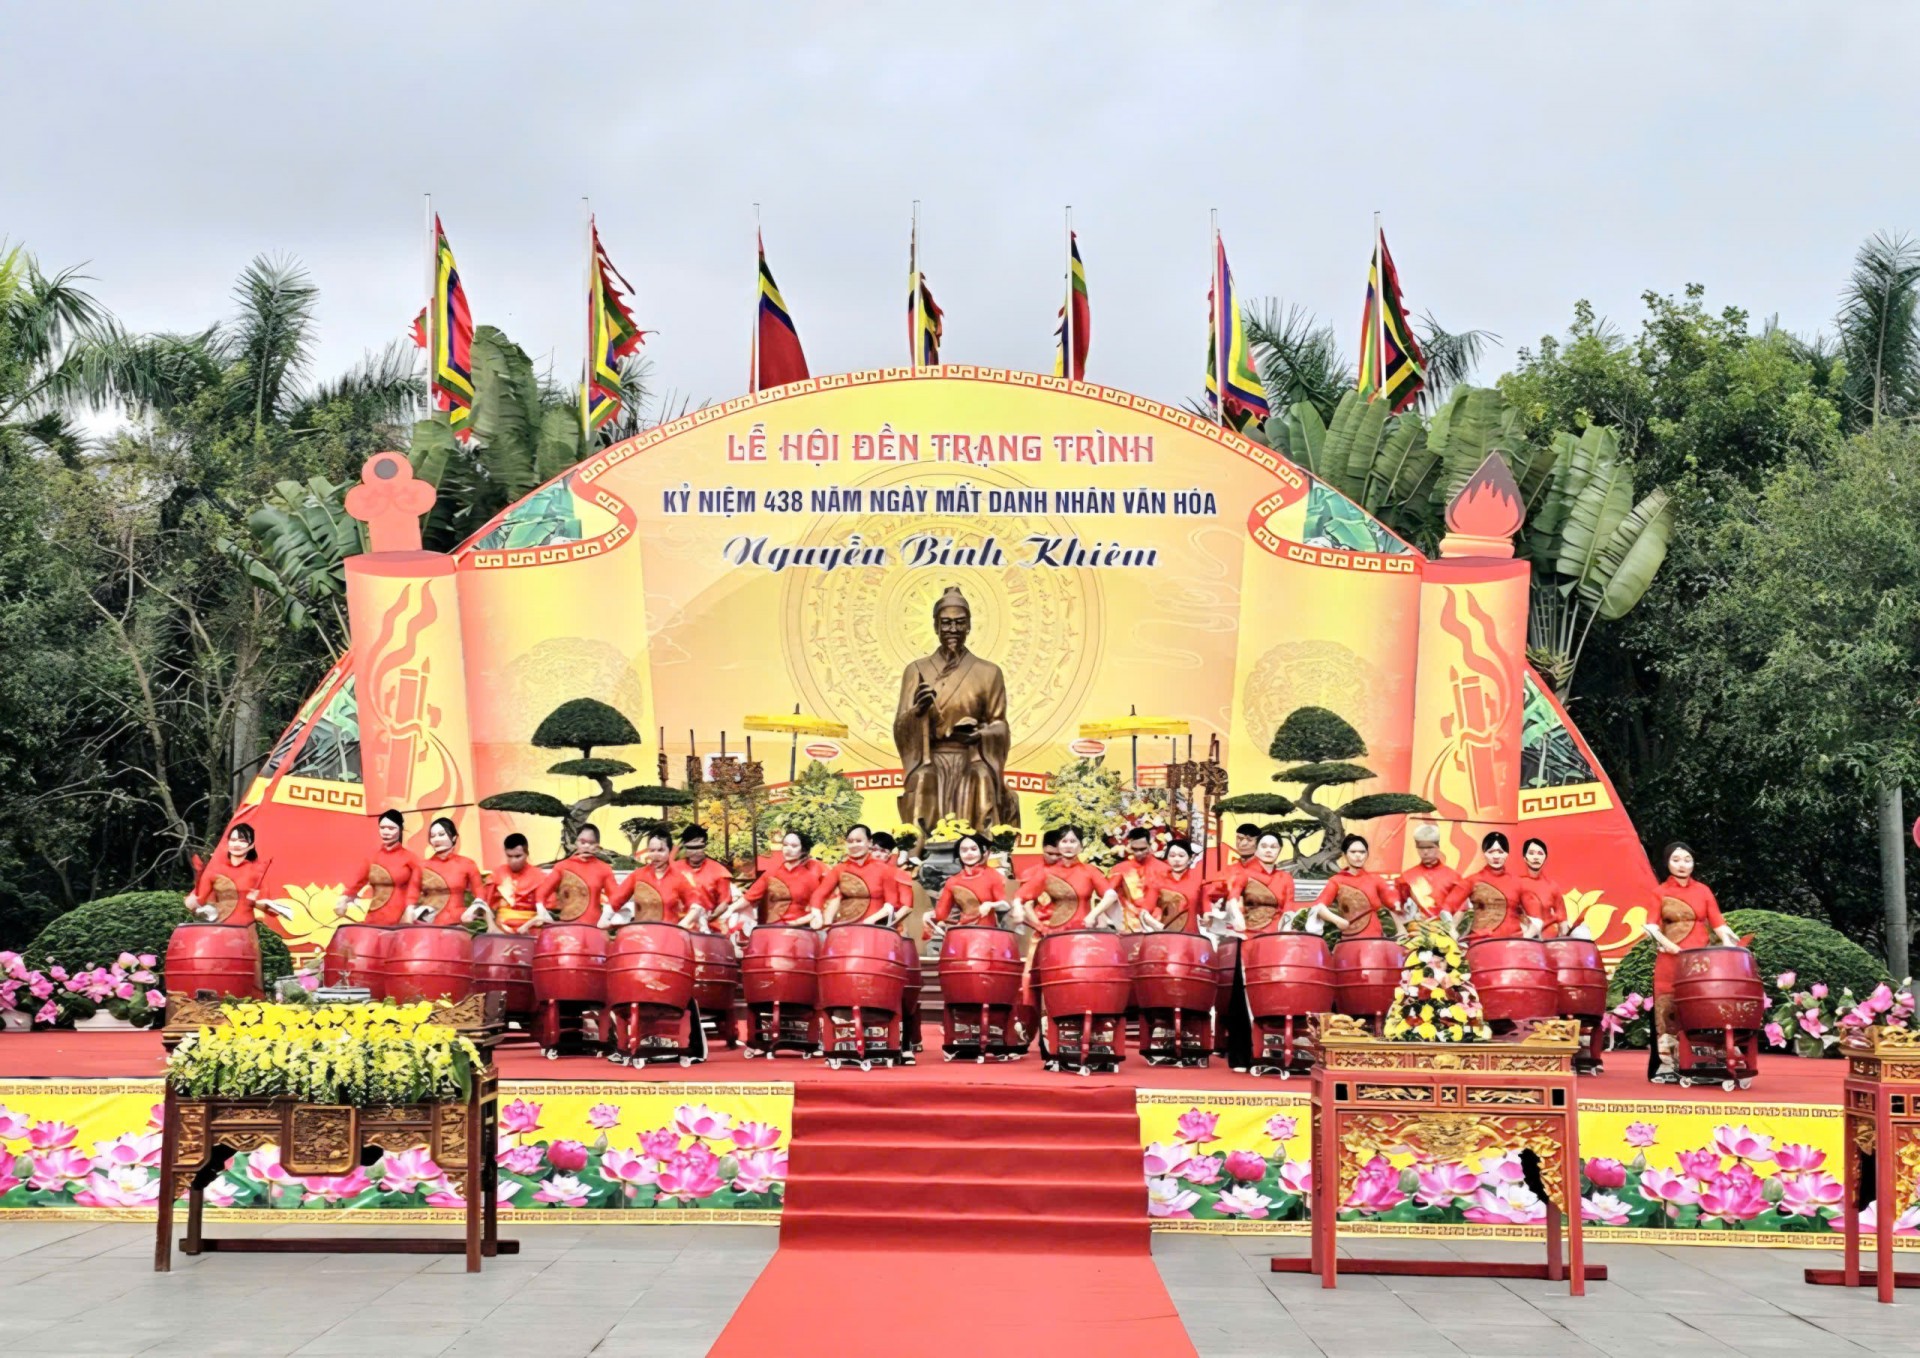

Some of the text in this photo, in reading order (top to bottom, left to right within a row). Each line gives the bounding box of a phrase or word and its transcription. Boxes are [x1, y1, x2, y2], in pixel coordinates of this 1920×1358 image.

[779, 428, 839, 467] HỘI
[852, 423, 918, 461] ĐỀN
[931, 434, 1041, 467] TRẠNG
[1053, 429, 1154, 465] TRÌNH
[663, 482, 1217, 517] KỶ NIỆM 438 NĂM NGÀY MẤT DANH NHÂN VĂN HÓA
[723, 535, 886, 572] Nguyễn
[1024, 537, 1157, 567] Khiêm
